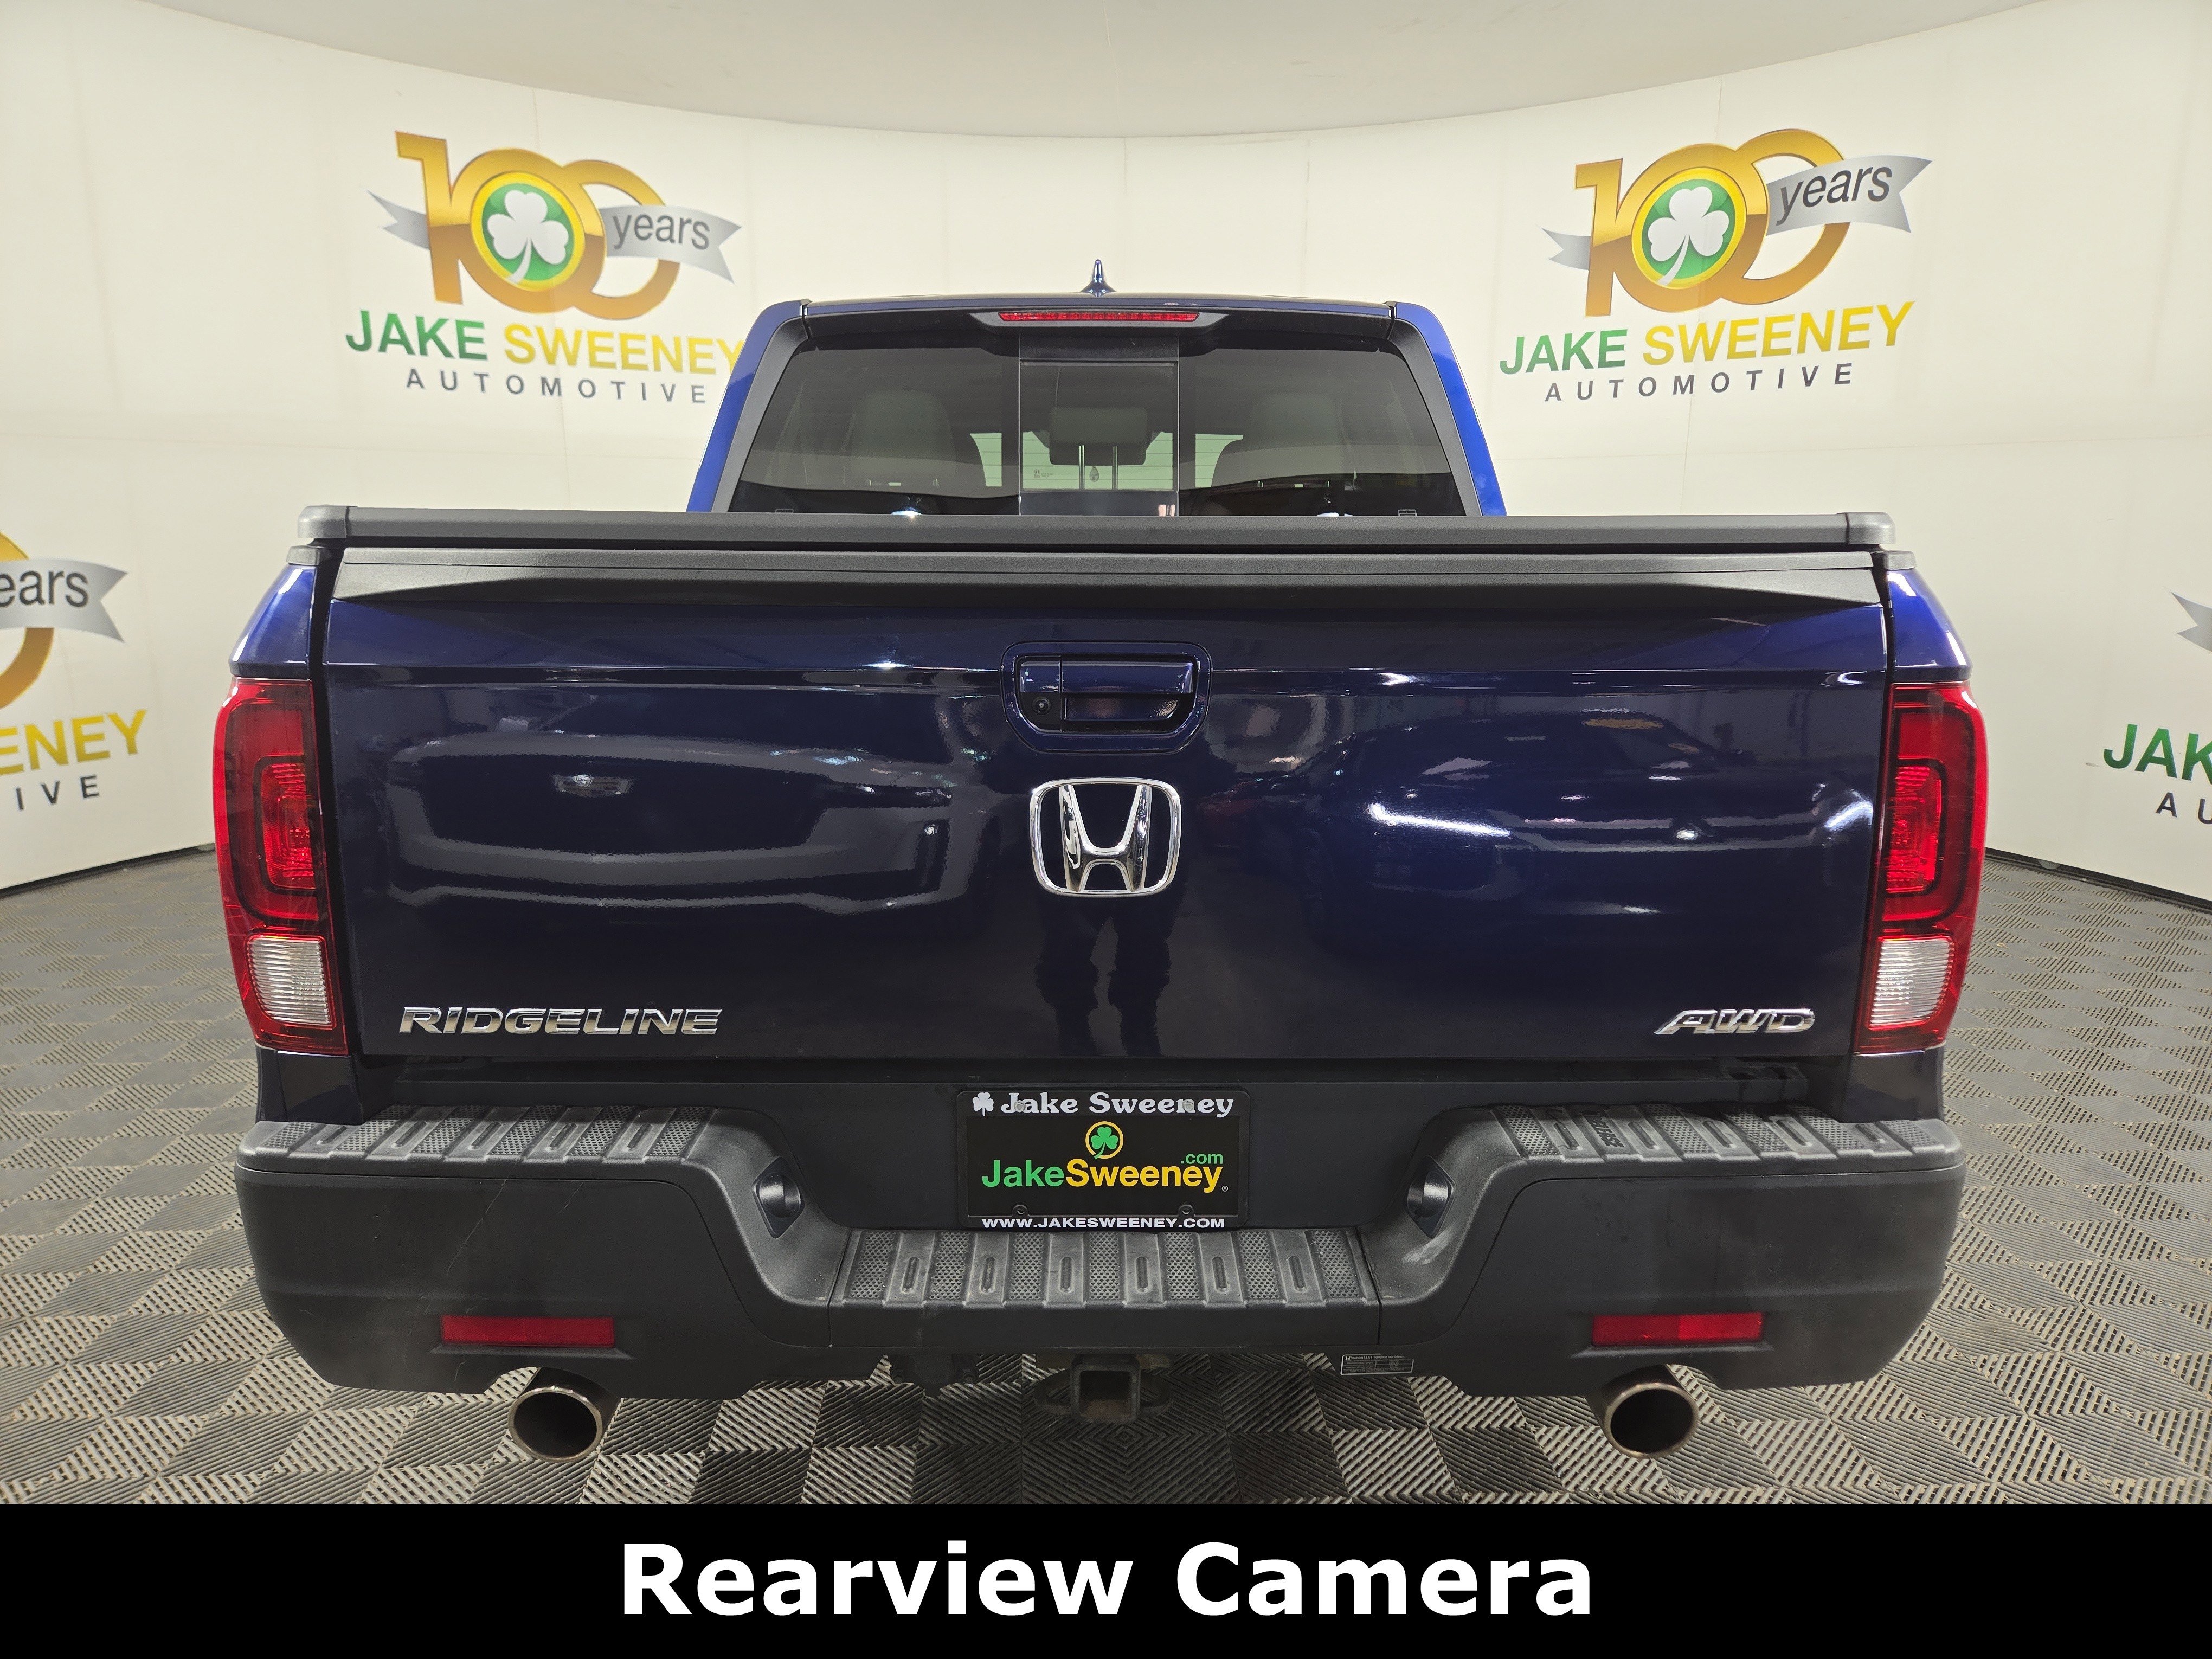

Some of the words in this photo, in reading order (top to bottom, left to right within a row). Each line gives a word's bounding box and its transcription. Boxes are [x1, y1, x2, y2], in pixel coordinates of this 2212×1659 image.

[1776, 163, 1892, 225] years
[612, 213, 711, 250] years
[346, 310, 488, 361] JAKE
[504, 323, 744, 375] SWEENEY
[1500, 329, 1628, 375] JAKE
[1643, 300, 1915, 366] SWEENEY
[407, 369, 705, 403] AUTOMOTIVE
[1545, 363, 1853, 402] AUTOMOTIVE
[2104, 724, 2212, 785] JAK
[16, 775, 99, 811] IVE
[399, 1007, 722, 1035] RIDGELINE
[1654, 1008, 1816, 1035] AWD
[1001, 1092, 1078, 1114] Jake
[1089, 1092, 1234, 1118] Sweeney
[982, 1159, 1223, 1193] JakeSweeney
[1180, 1154, 1223, 1165] .com
[982, 1218, 1225, 1229] WWW.JAKESWEENEY.COM
